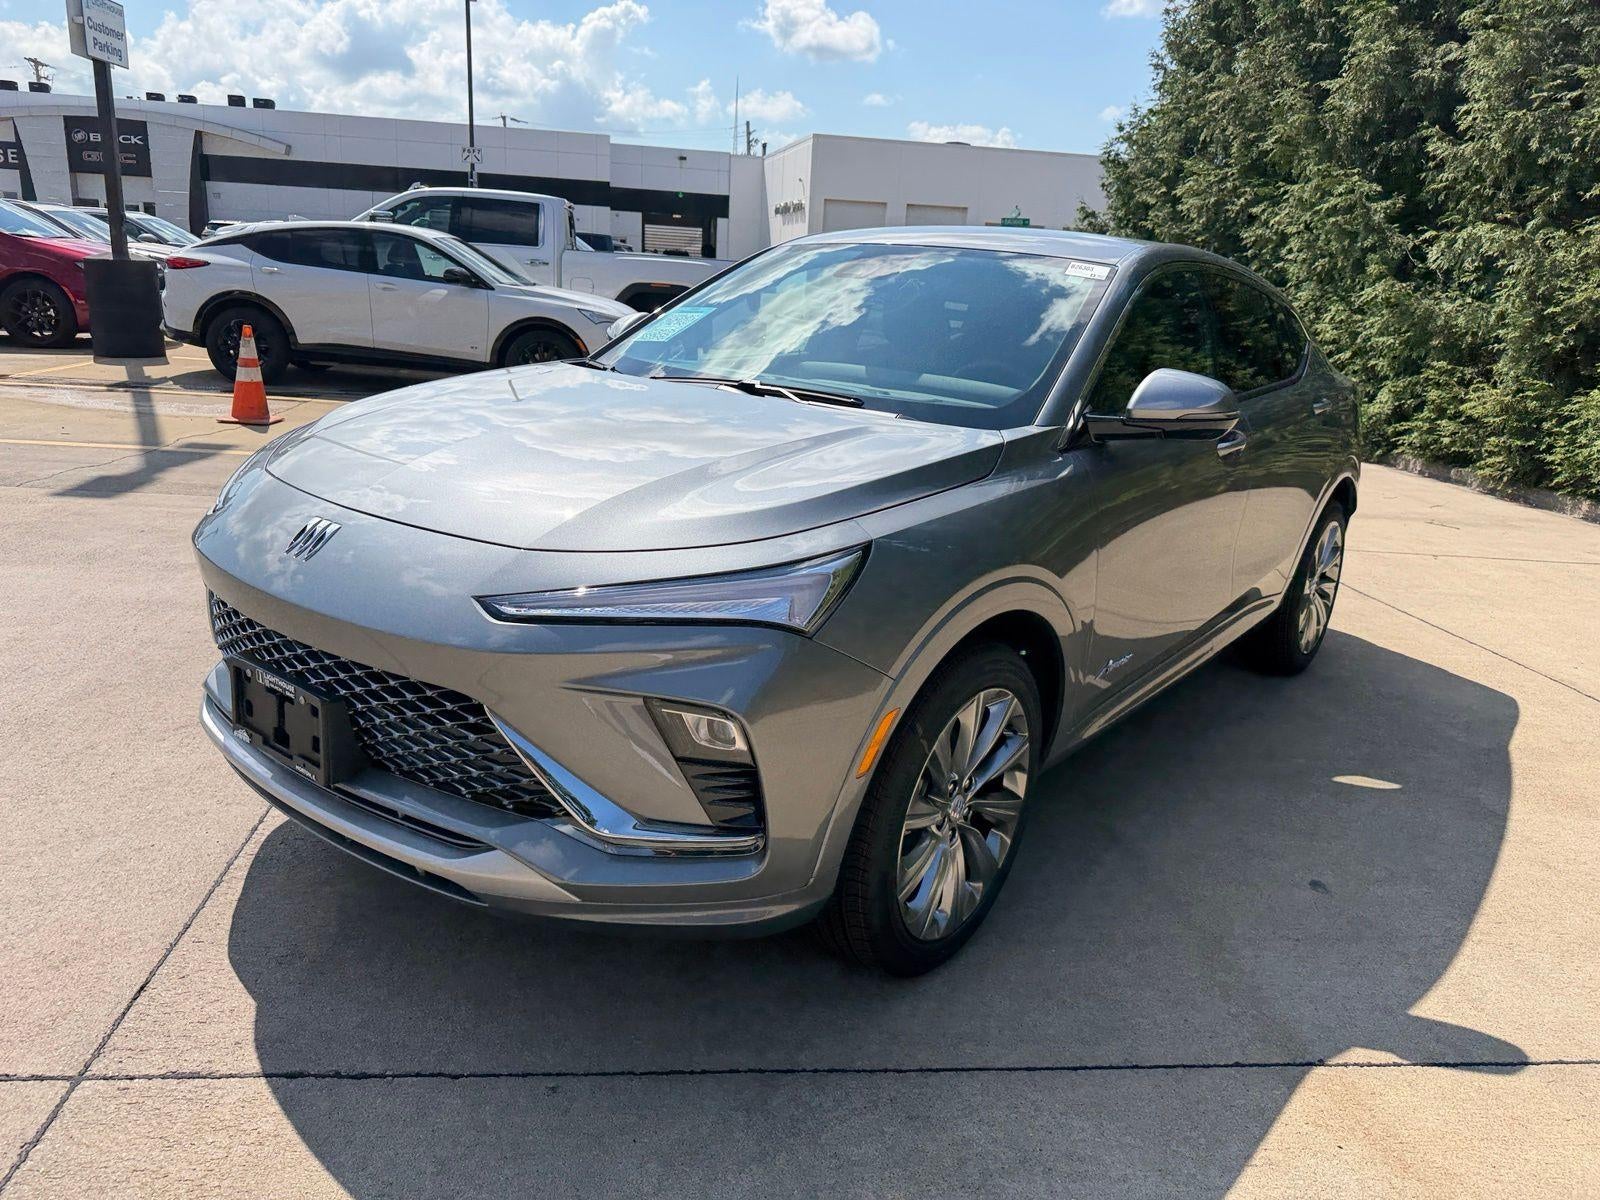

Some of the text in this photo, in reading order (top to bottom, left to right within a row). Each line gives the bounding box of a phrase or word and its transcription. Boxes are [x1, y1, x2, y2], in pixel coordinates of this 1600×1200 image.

[87, 16, 124, 41] Customer
[92, 36, 123, 61] Parking
[89, 132, 143, 145] BCK
[82, 150, 137, 164] GC
